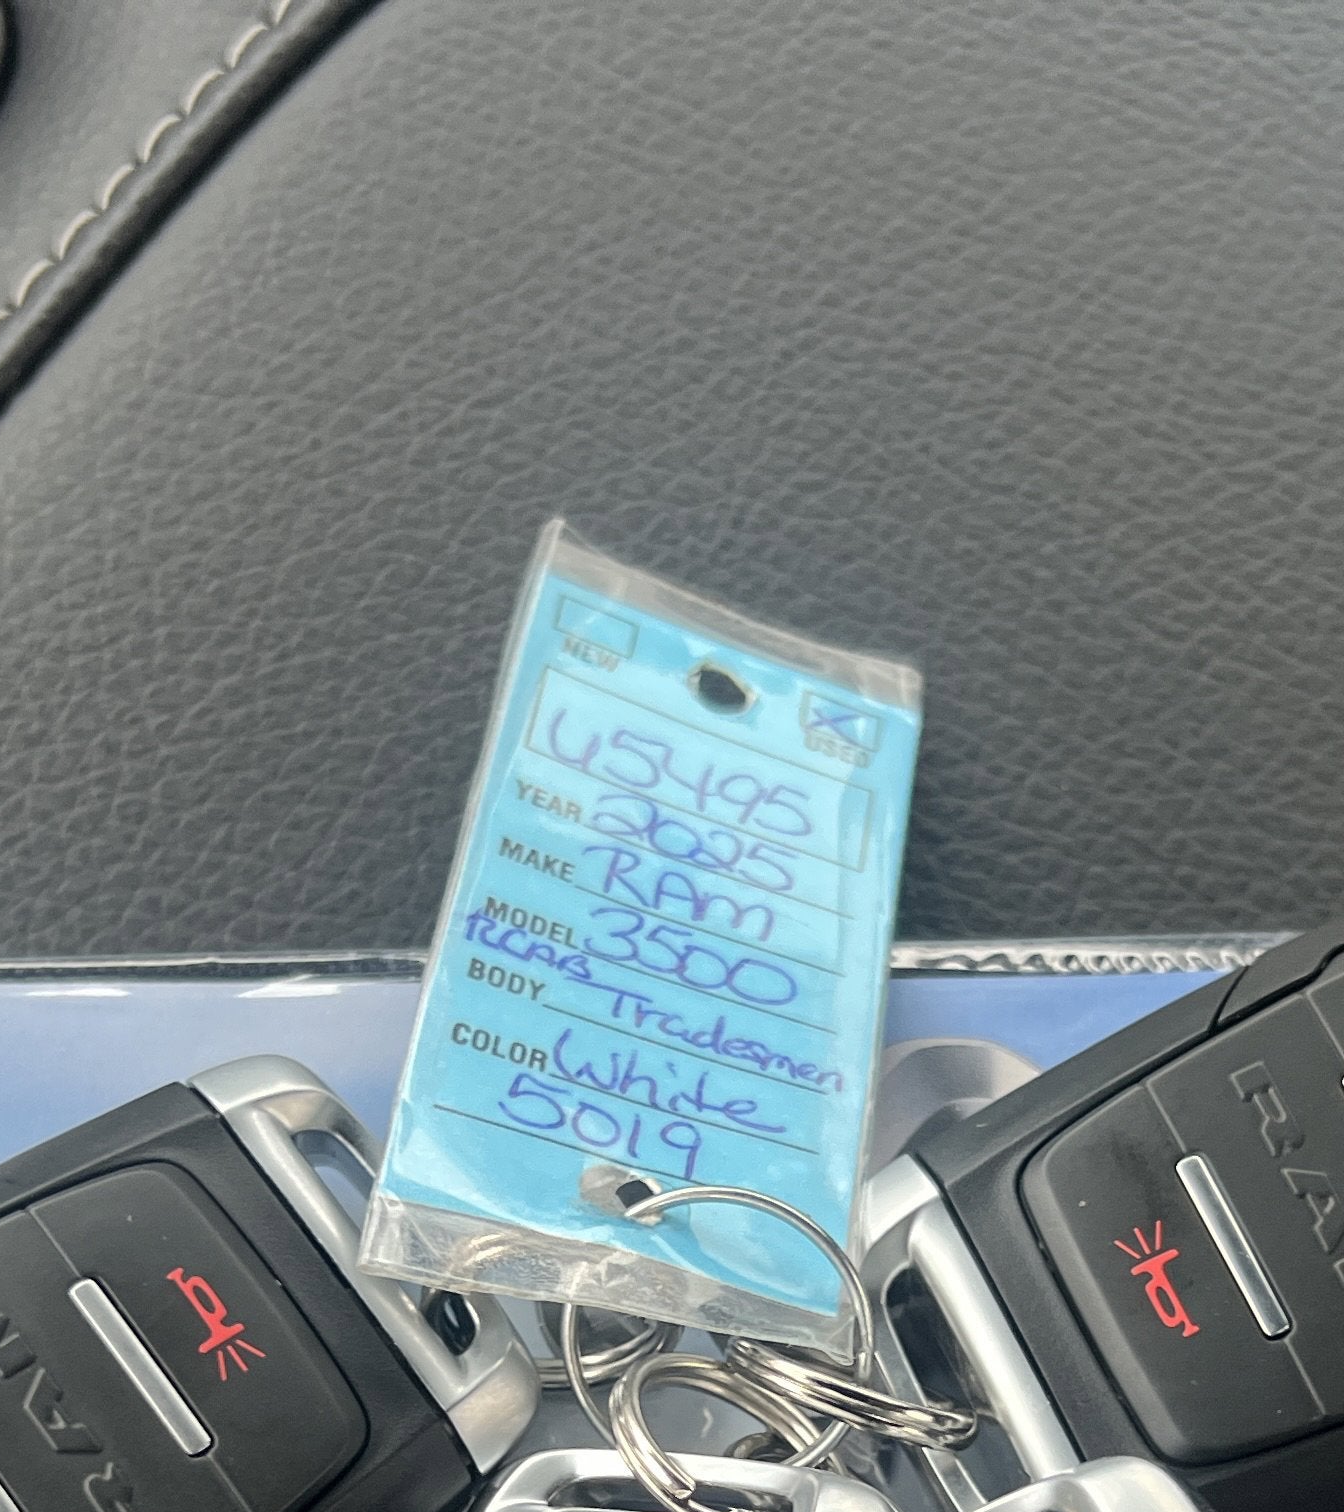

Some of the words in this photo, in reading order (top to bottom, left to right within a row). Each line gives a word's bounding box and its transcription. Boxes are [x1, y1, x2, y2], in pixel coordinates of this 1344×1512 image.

[563, 635, 621, 673] NEW
[803, 730, 871, 769] USED
[514, 778, 584, 824] YEAR
[498, 837, 576, 883] MAKE
[592, 792, 794, 892] 2025
[484, 896, 578, 950] MODEL
[467, 957, 547, 1001] BODY
[583, 907, 798, 1006] 3500
[451, 1022, 549, 1073] COLOR
[553, 1028, 788, 1134] White
[498, 1074, 703, 1180] 5019
